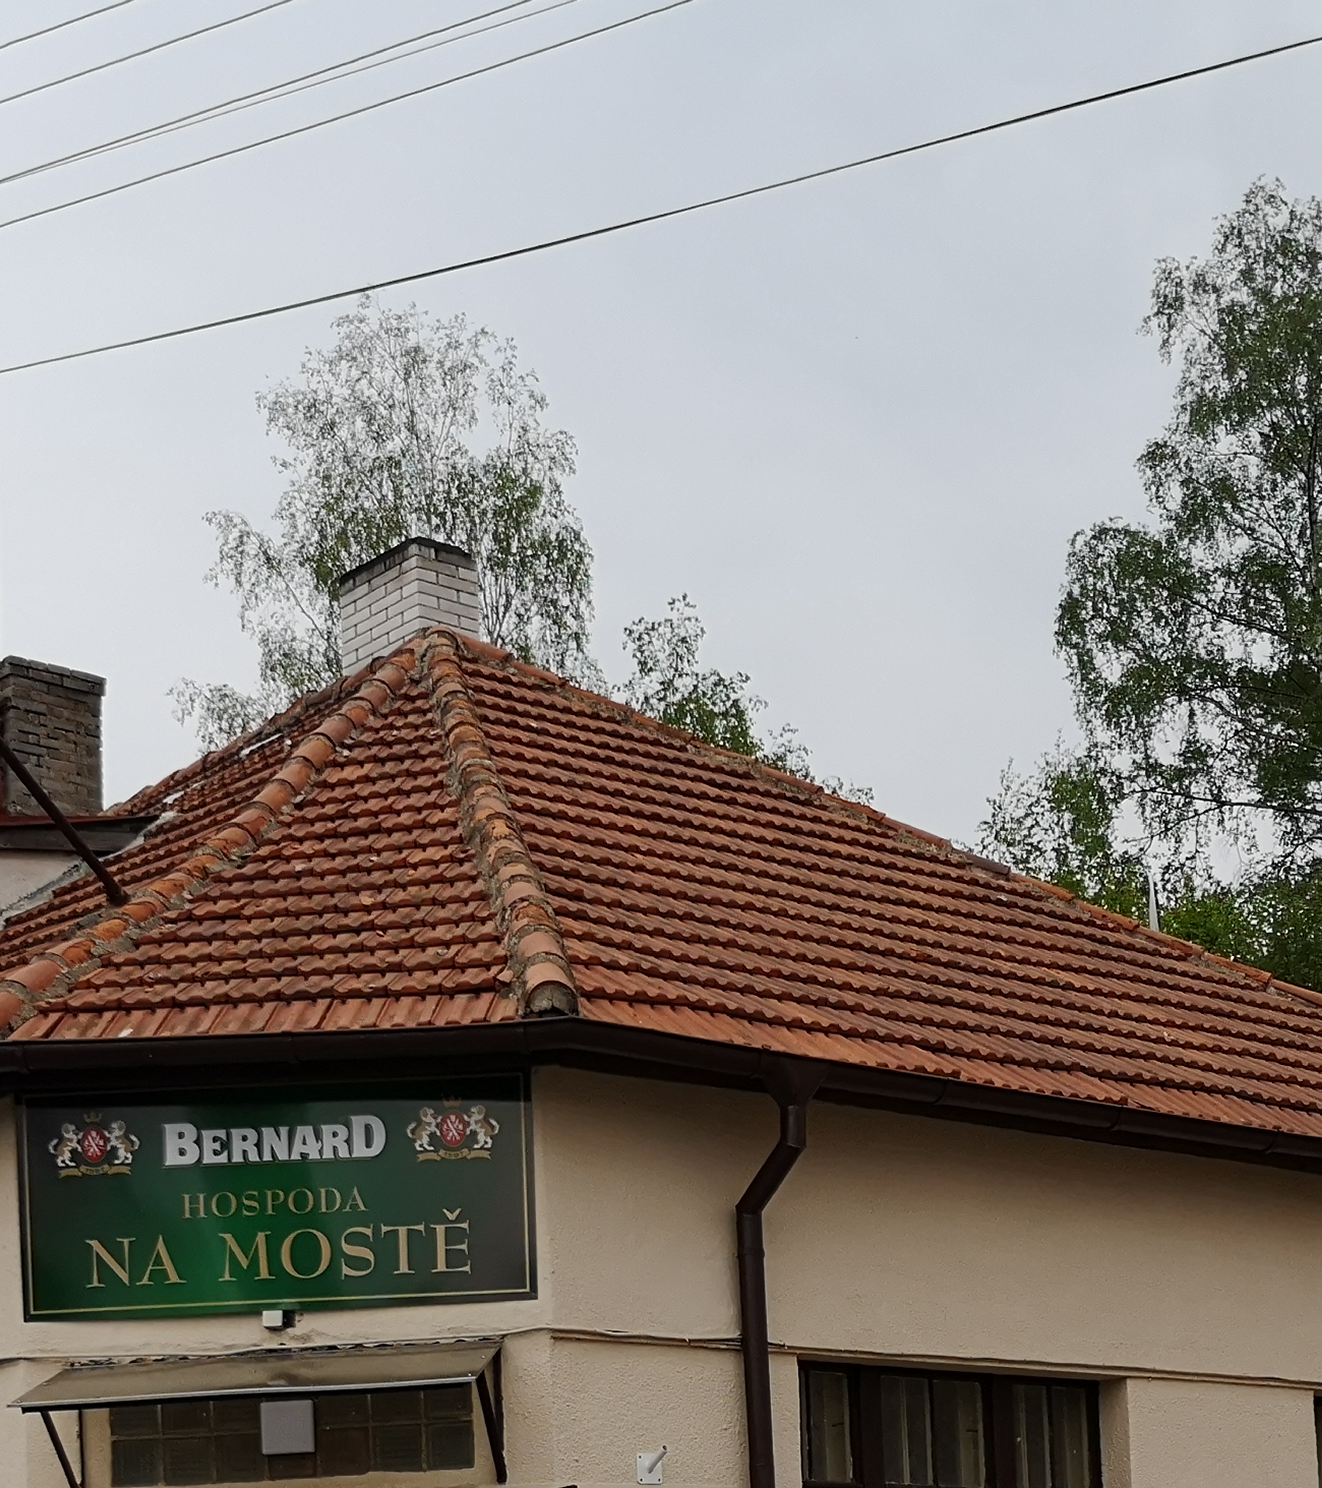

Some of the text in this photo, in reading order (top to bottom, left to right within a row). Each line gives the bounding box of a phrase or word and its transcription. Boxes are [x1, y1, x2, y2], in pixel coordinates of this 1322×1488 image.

[162, 1114, 387, 1168] BERNARD
[181, 1186, 369, 1220] HOSPODA
[85, 1207, 472, 1289] NA MOSTĚ
